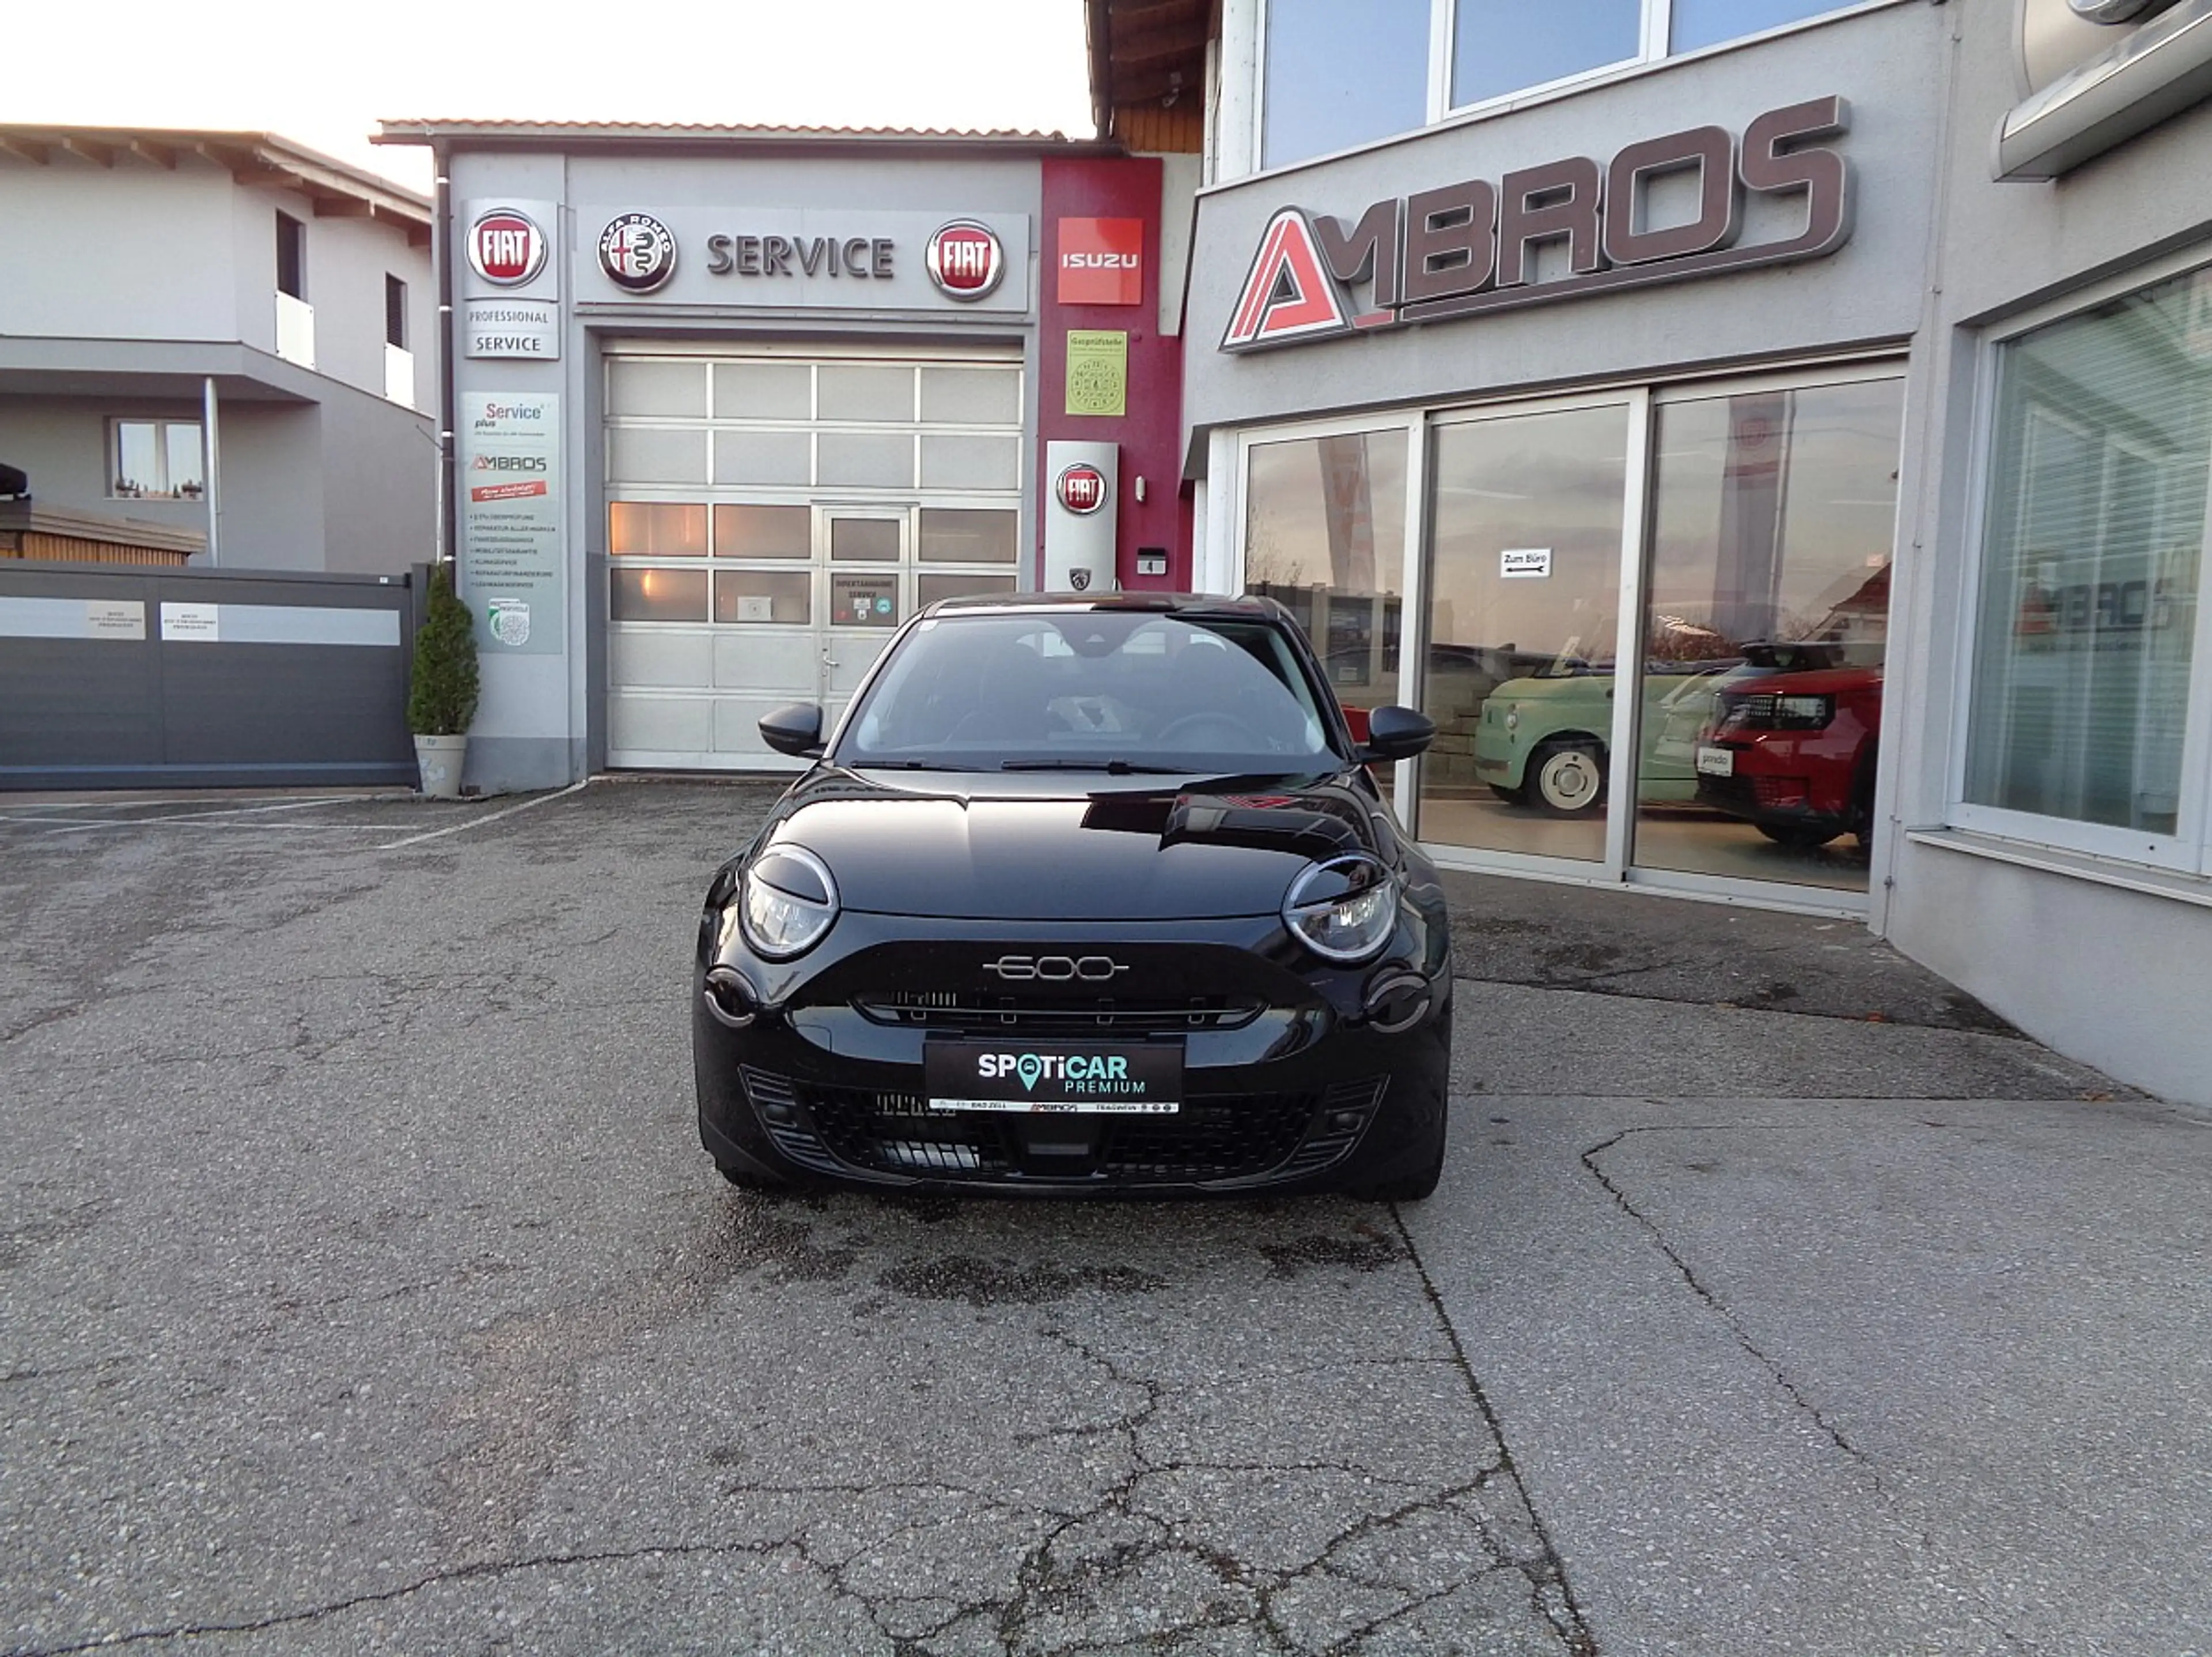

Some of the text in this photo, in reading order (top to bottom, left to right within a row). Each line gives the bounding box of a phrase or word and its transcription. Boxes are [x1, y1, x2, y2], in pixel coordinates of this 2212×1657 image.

[1220, 95, 1854, 348] AMBROS
[601, 215, 672, 252] ALFA ROMEO
[482, 230, 528, 266] FIAT
[707, 234, 894, 279] SERVICE
[942, 240, 988, 278] FIAT
[1062, 254, 1138, 268] ISUZU
[469, 311, 548, 324] PROFESSIONAL
[476, 337, 541, 351] SERVICE
[486, 403, 541, 419] Service
[471, 453, 547, 472] AMBROS
[1067, 479, 1097, 501] FIAT
[1504, 553, 1547, 563] Zum Büro
[997, 955, 1115, 979] 600
[1065, 1081, 1146, 1094] PREMIUM
